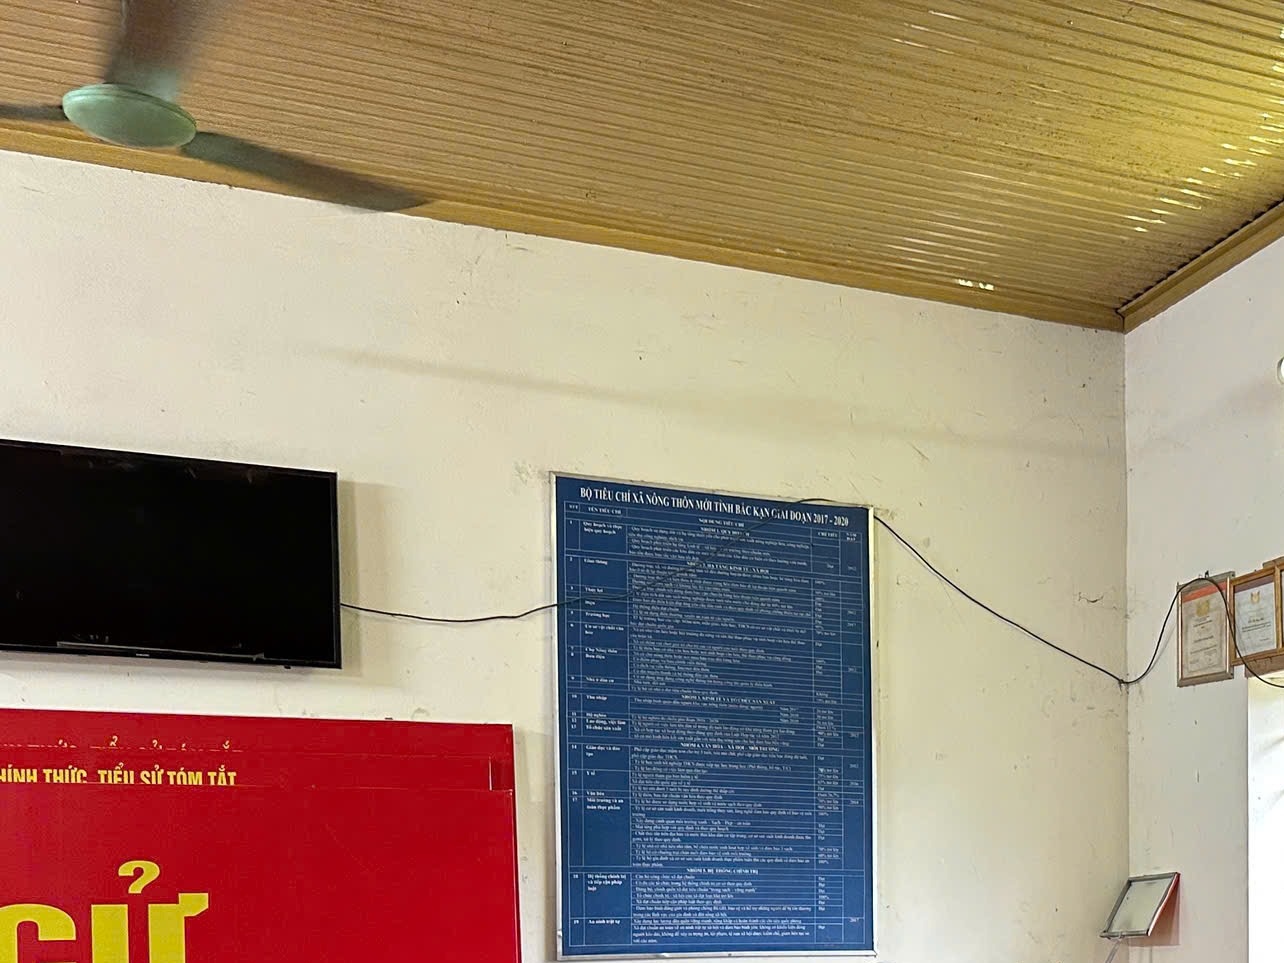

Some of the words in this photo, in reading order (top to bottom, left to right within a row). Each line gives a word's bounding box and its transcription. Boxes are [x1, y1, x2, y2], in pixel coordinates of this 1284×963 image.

[580, 487, 592, 501] BỘ
[594, 488, 614, 501] TIÊU
[616, 490, 632, 502] CHÍ
[646, 493, 670, 507] NÔNG
[671, 496, 694, 510] THÔN
[813, 513, 829, 525] 2017
[834, 515, 849, 528] 2020
